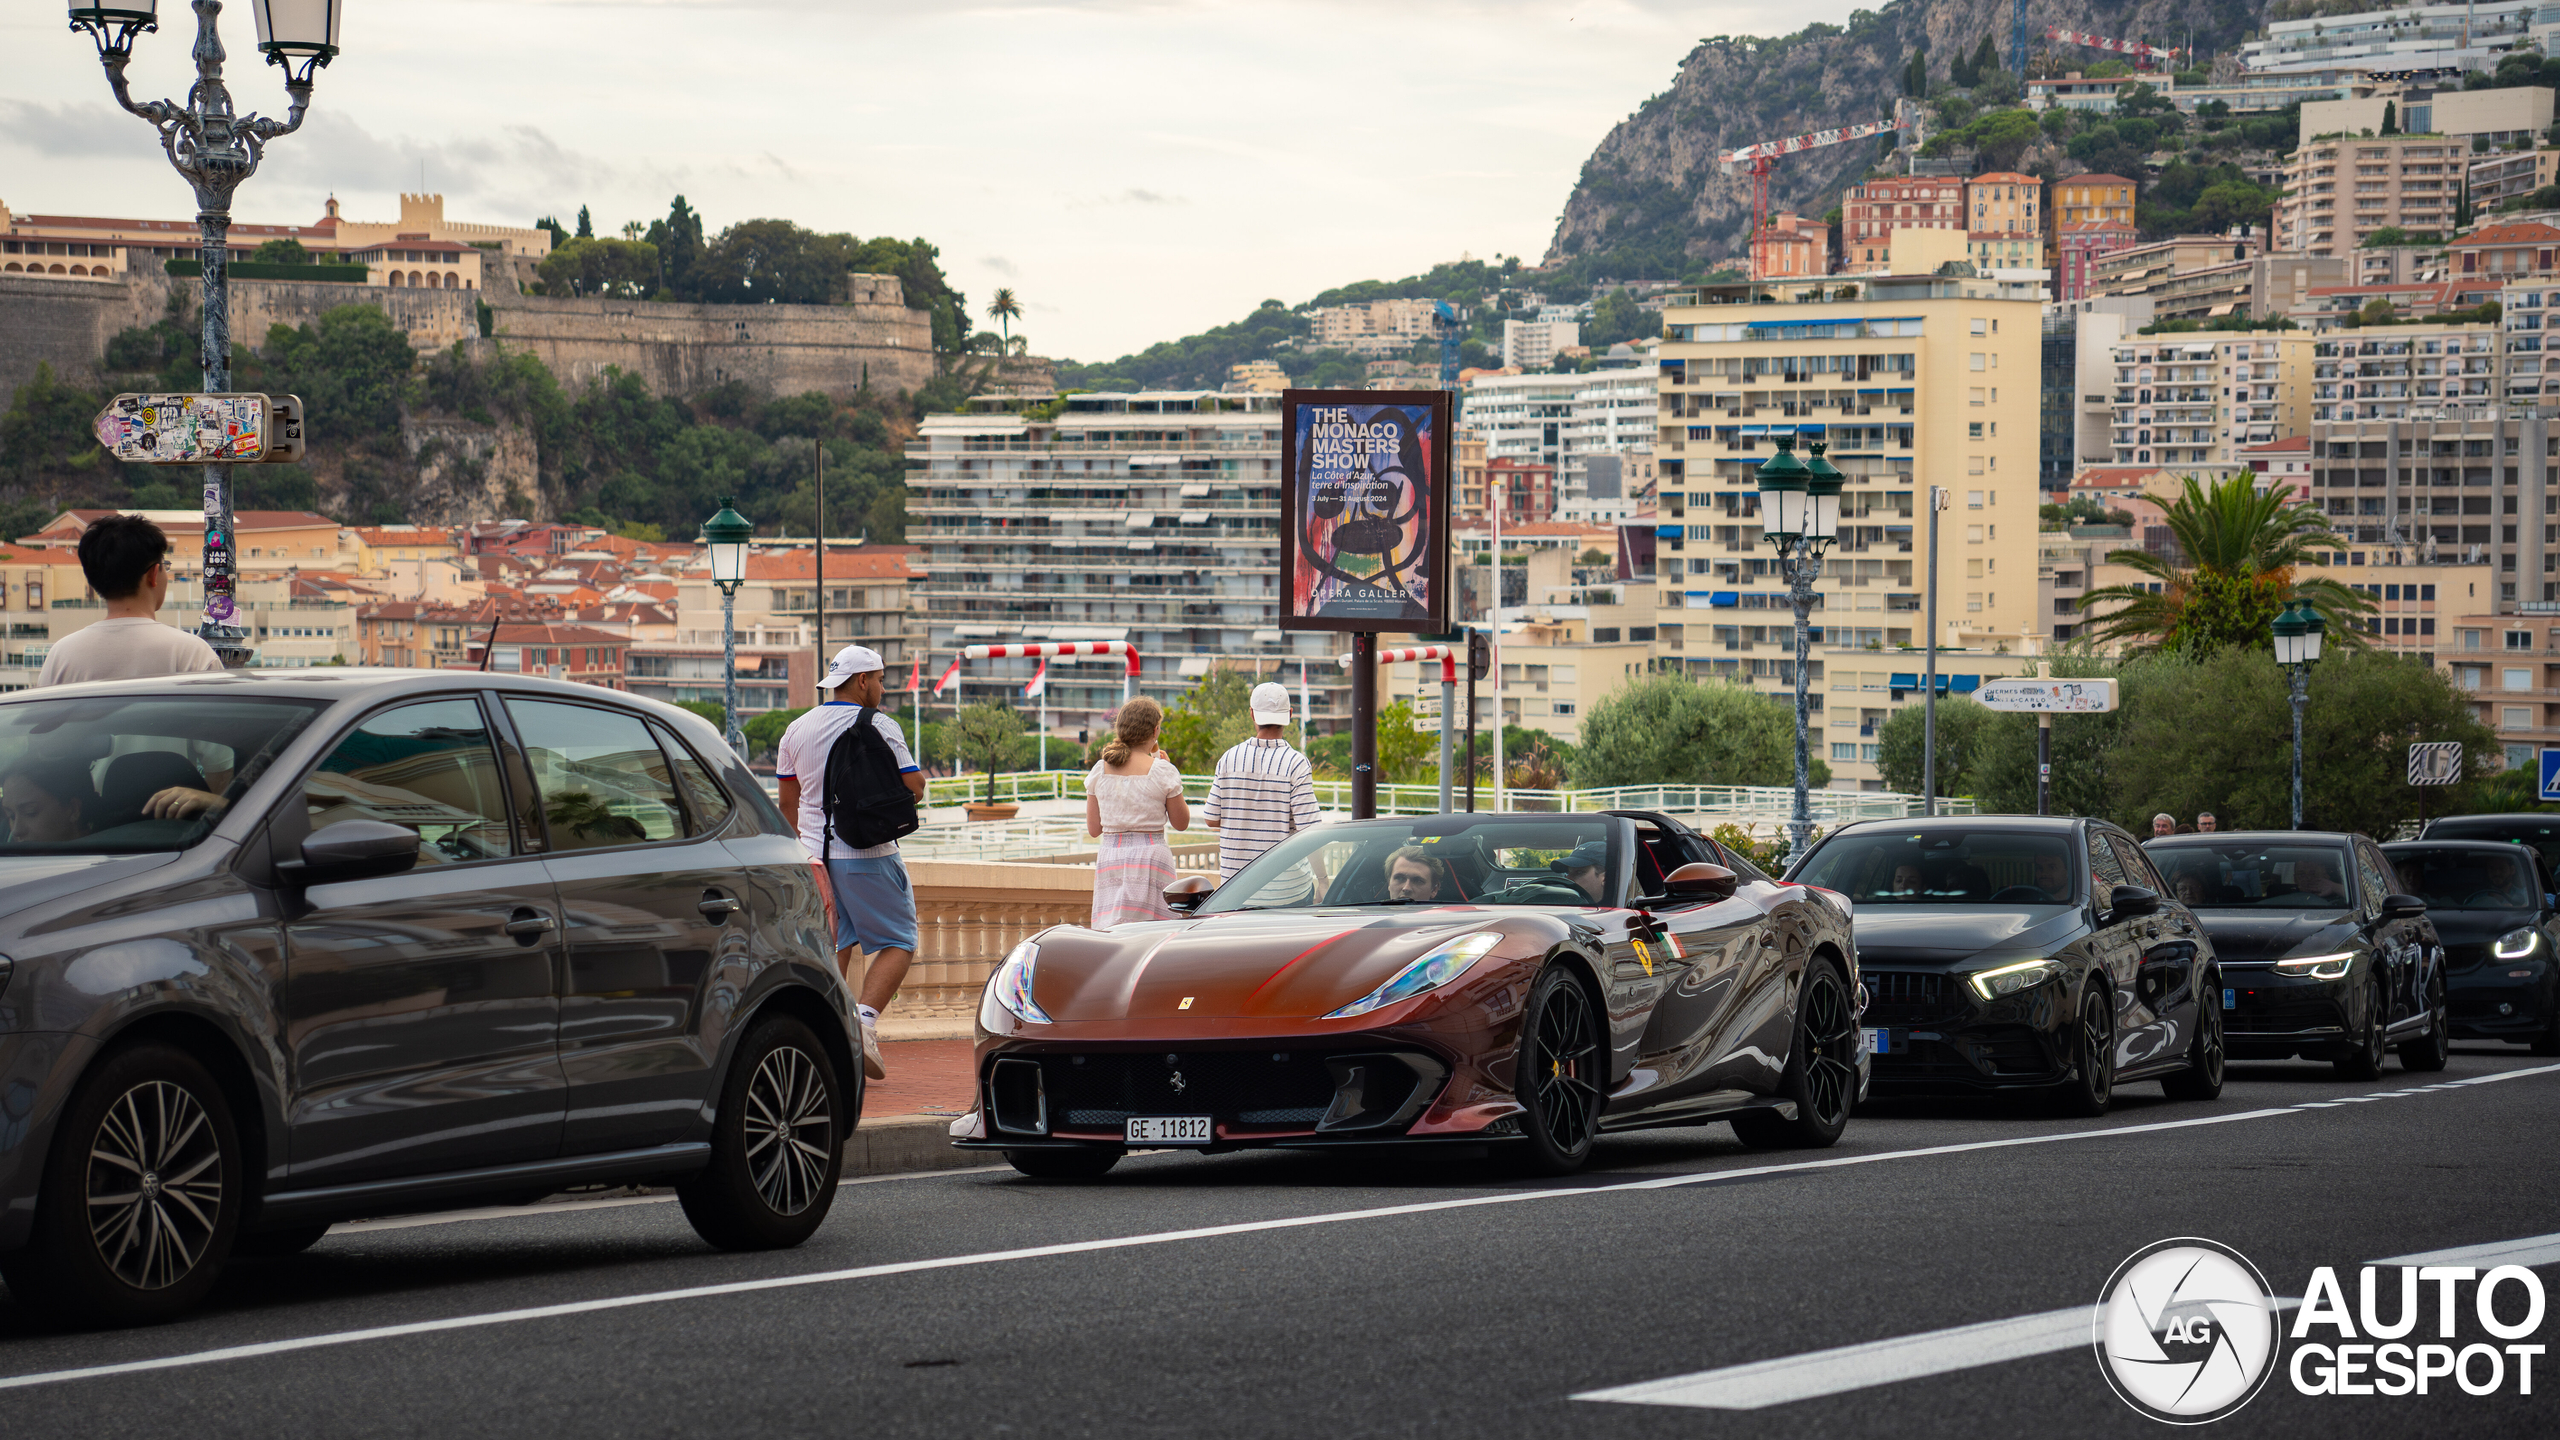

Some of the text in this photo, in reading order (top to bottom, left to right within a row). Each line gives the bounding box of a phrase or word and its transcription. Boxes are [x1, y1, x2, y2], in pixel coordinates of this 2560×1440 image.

[1312, 408, 1347, 423] THE
[1312, 423, 1398, 438] MONACO
[1312, 438, 1400, 454] MASTERS
[1312, 453, 1370, 469] SHOW
[1312, 471, 1376, 481] La Côte d'Azur,
[1312, 481, 1333, 490] terre
[1317, 495, 1329, 503] July
[1347, 495, 1369, 503] August
[1311, 589, 1414, 599] OPERA GALLERY
[2225, 999, 2234, 1007] 69
[1160, 1119, 1206, 1138] 11812
